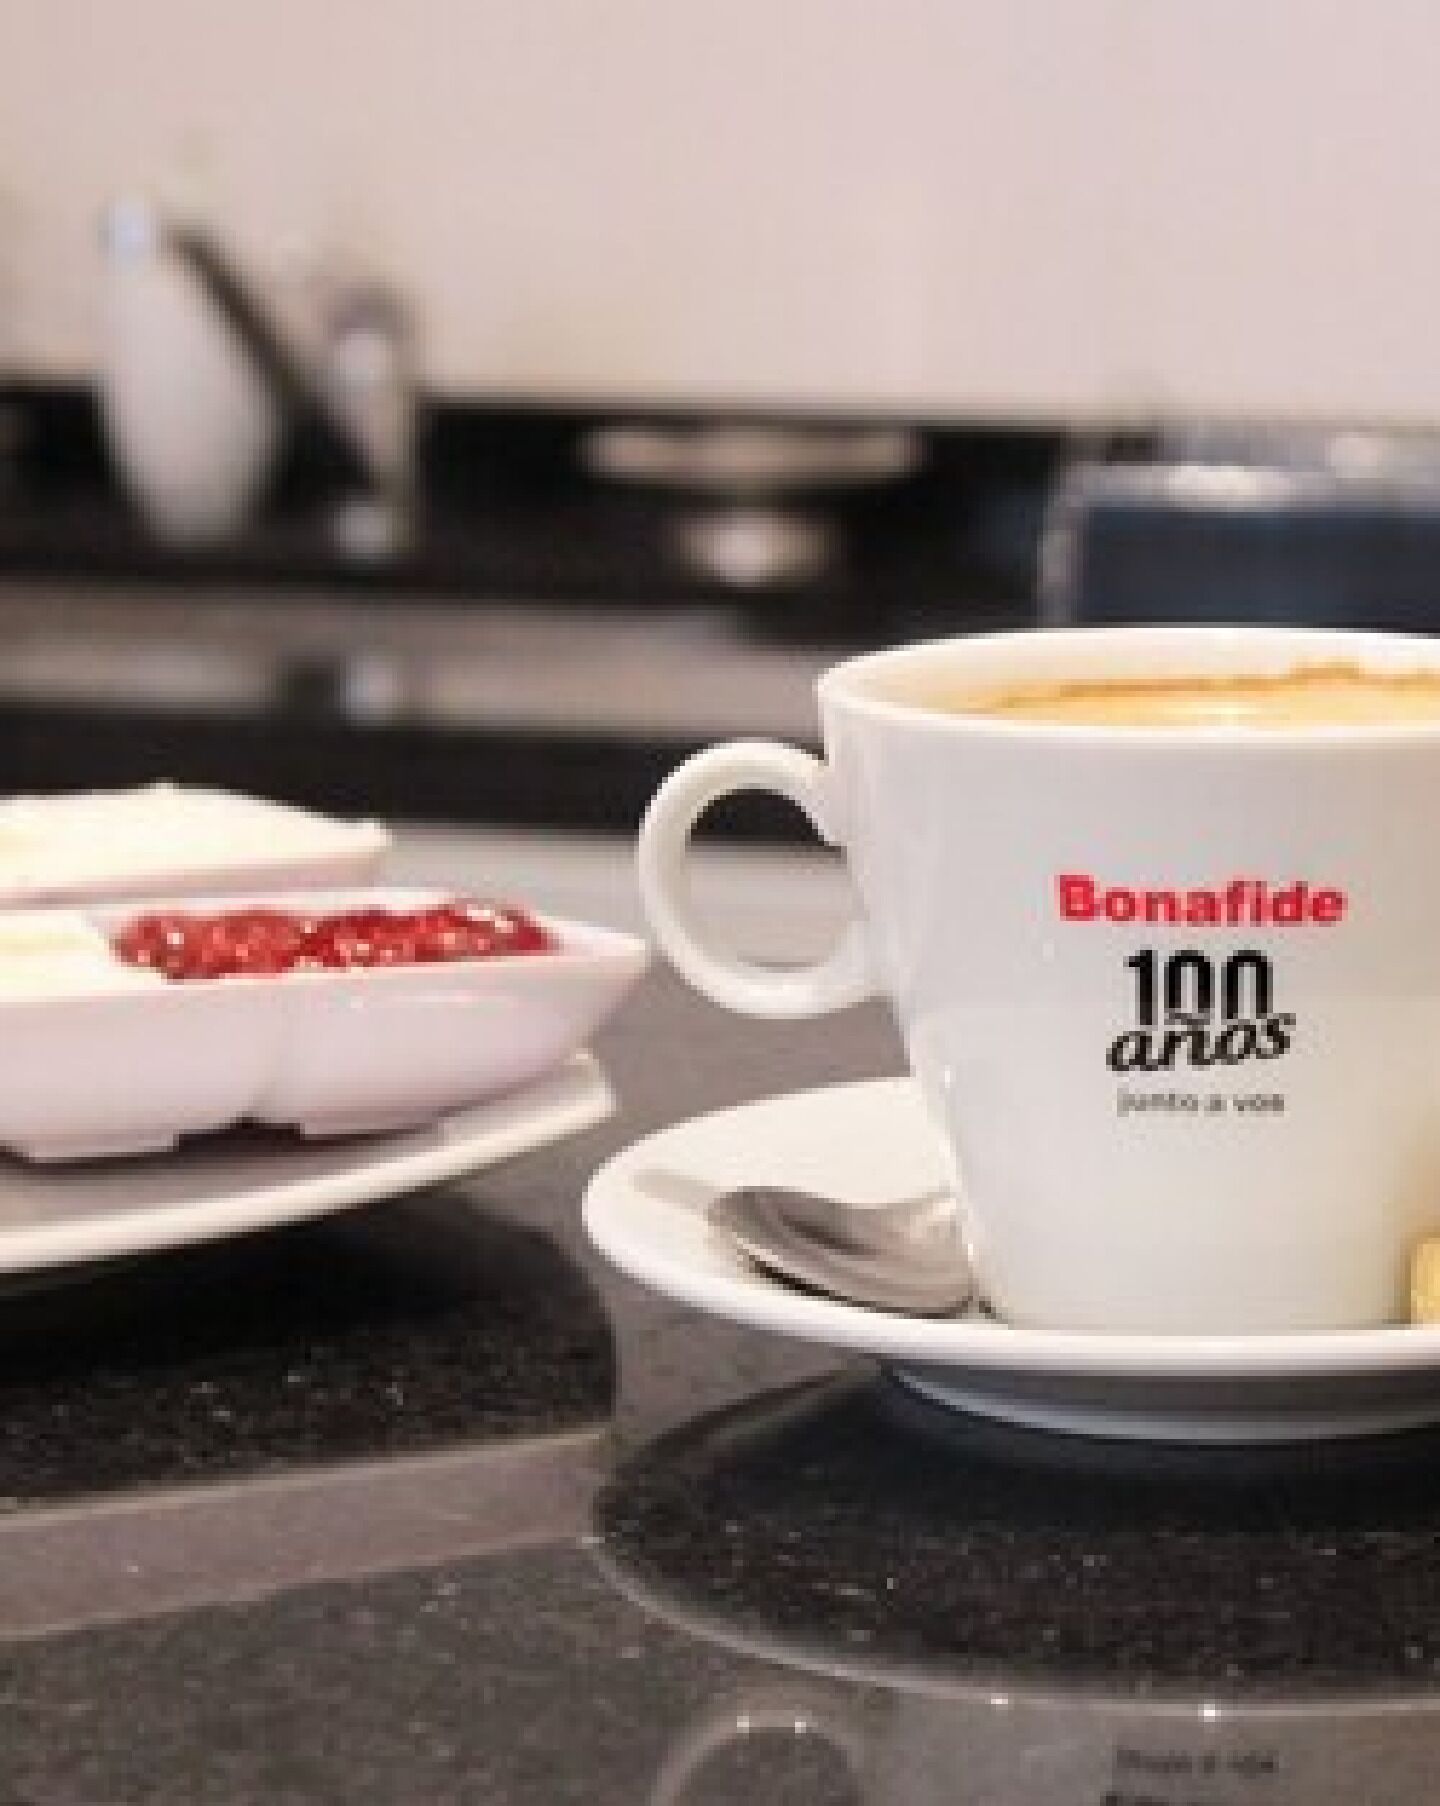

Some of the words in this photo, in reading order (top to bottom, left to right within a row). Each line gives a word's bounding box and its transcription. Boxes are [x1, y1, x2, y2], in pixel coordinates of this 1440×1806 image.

[1058, 874, 1347, 926] Bonafide
[1123, 949, 1273, 1025] 100
[1106, 1012, 1296, 1071] años
